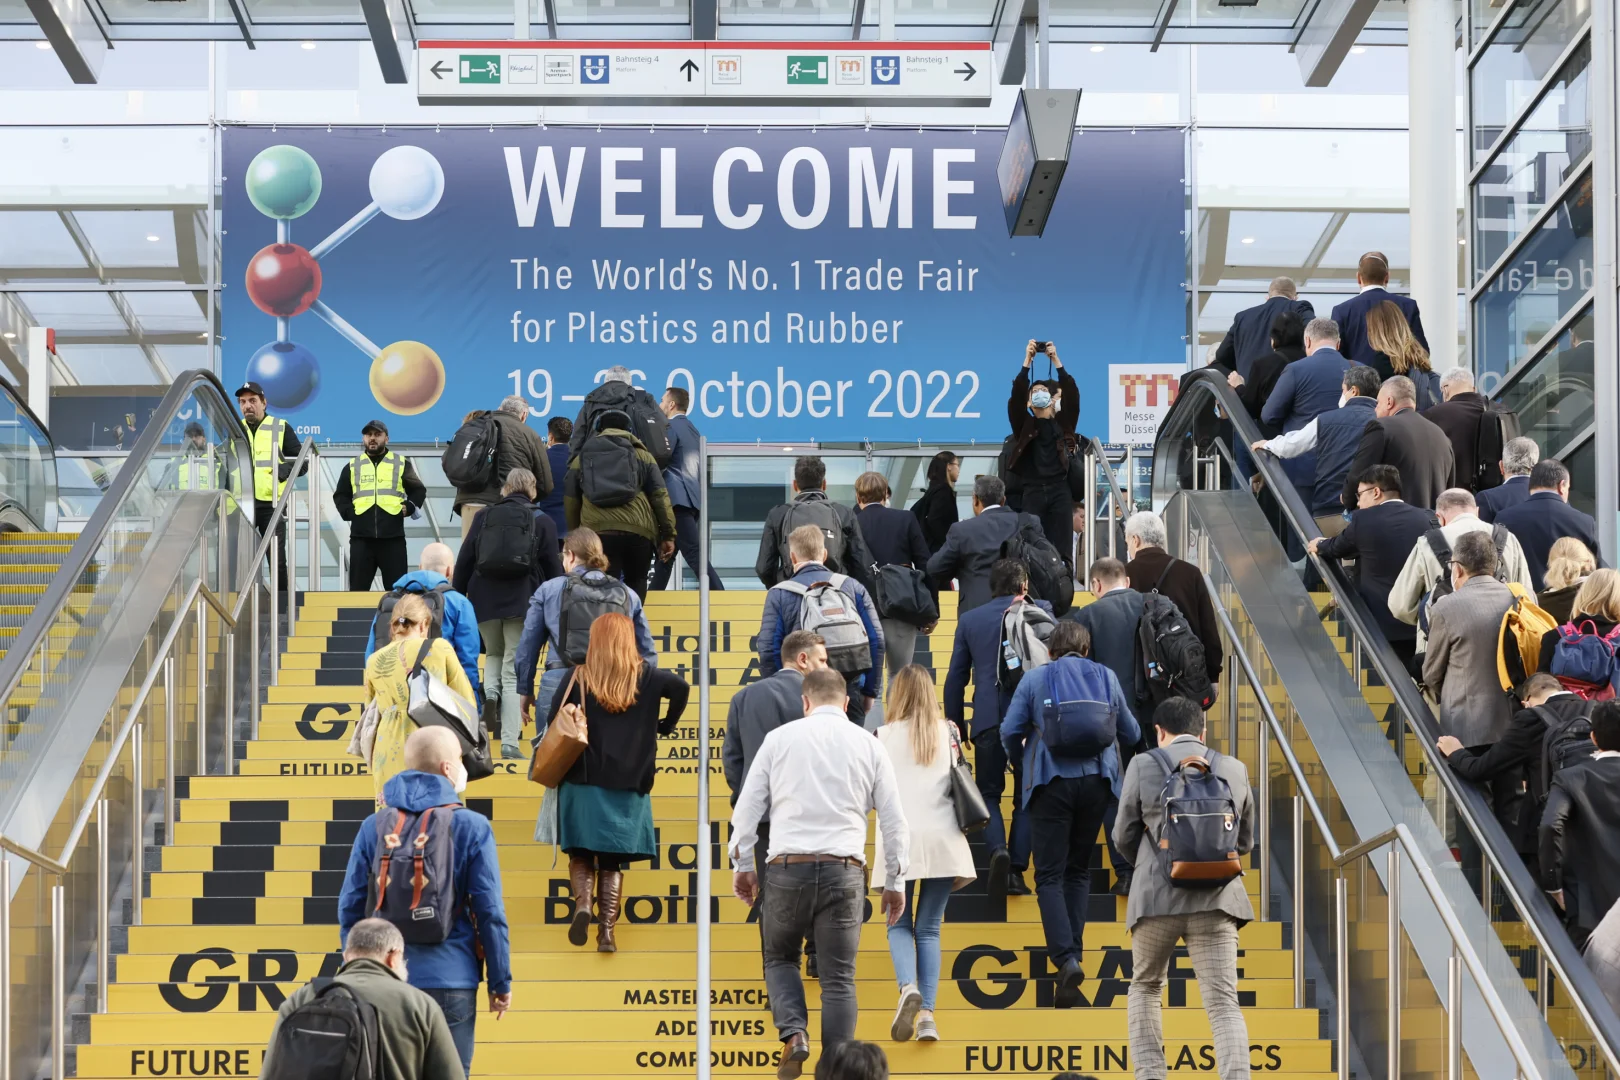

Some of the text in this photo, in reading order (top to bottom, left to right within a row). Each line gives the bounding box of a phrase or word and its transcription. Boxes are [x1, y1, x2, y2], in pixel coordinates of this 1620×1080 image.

[615, 56, 652, 64] Bahnsteig
[906, 56, 943, 64] Bahnsteig
[503, 145, 978, 230] WELCOME
[510, 258, 980, 292] The World’s No. 1 Trade Fair
[510, 311, 904, 345] for Plastics and Rubber
[665, 366, 853, 419] October
[867, 369, 982, 419] 2022
[1124, 412, 1155, 421] Messe
[1124, 424, 1158, 434] Düssel
[655, 1020, 765, 1036] ADDTIVES
[130, 1049, 250, 1077] FUTURE
[965, 1045, 1083, 1072] FUTURE
[1094, 1046, 1129, 1072] IN
